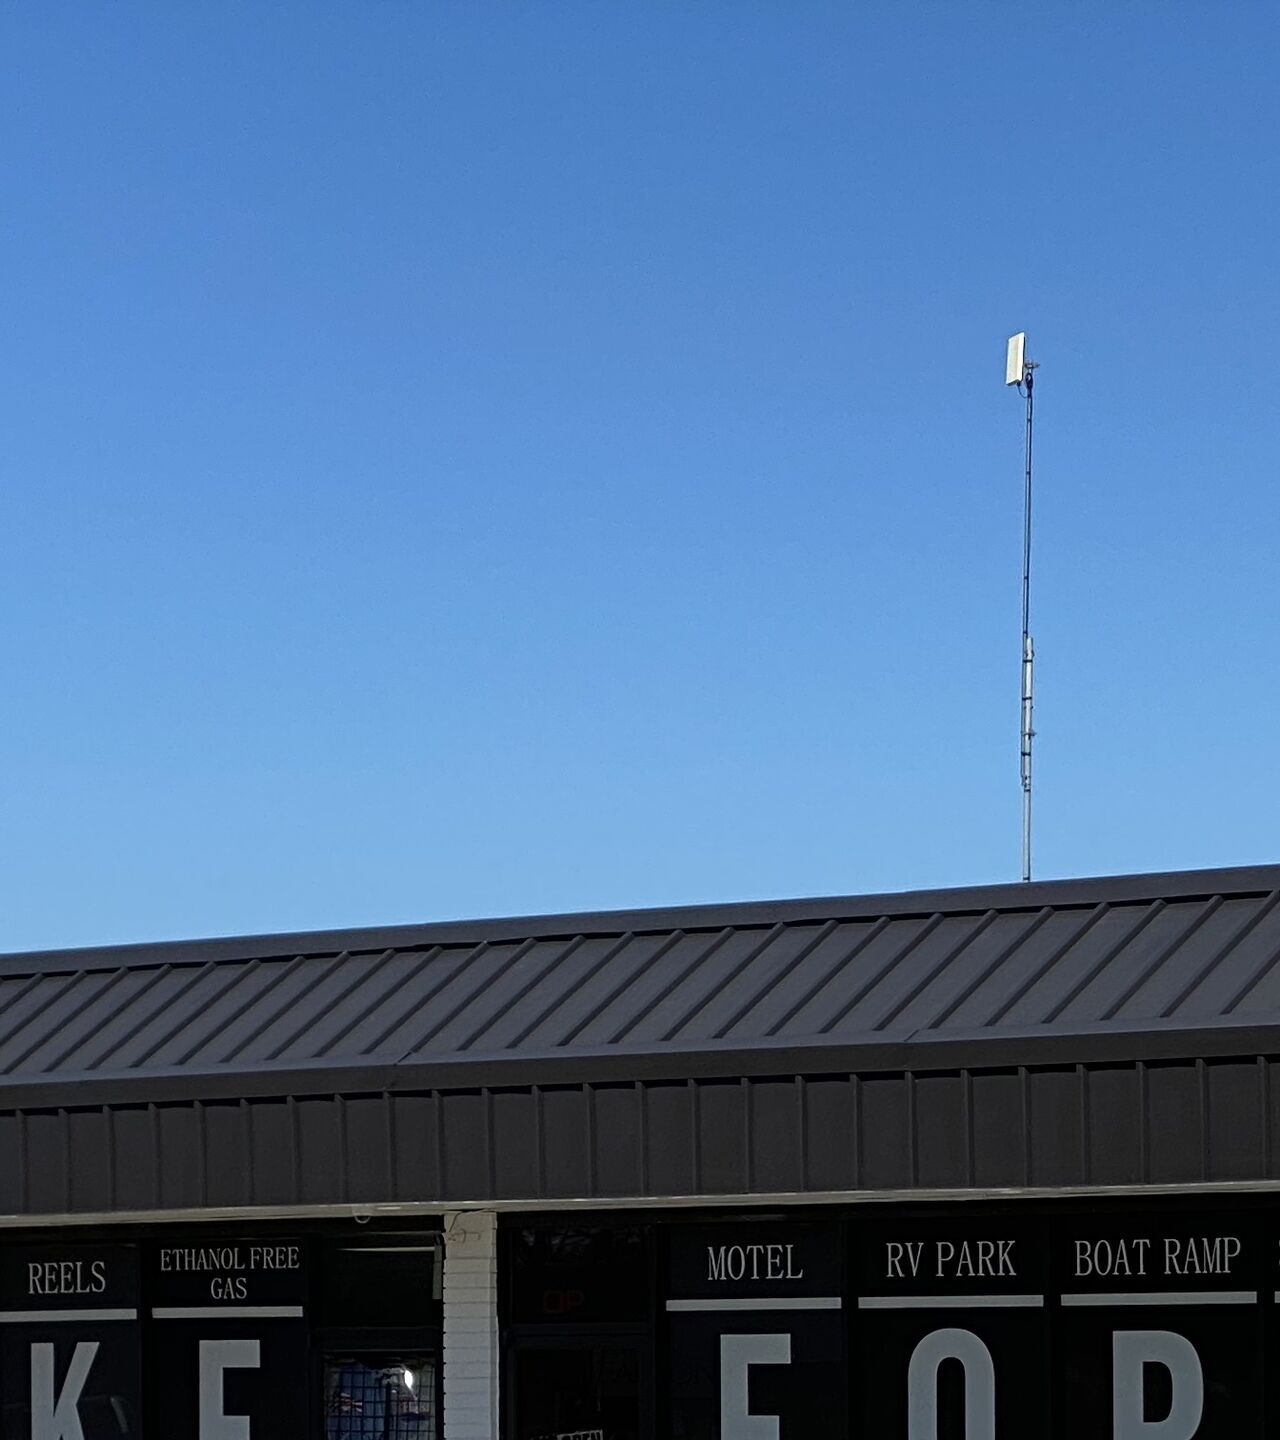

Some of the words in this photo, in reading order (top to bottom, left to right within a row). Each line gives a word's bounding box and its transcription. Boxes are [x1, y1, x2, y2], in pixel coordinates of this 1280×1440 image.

[160, 1248, 245, 1271] ETHANOL
[250, 1246, 300, 1269] FREE
[707, 1244, 804, 1280] MOTEL
[886, 1242, 924, 1278] RV
[935, 1240, 1017, 1277] PARK
[1074, 1238, 1151, 1276] BOAT
[1163, 1237, 1241, 1275] RAMP
[28, 1261, 106, 1294] REELS
[210, 1277, 247, 1299] GAS
